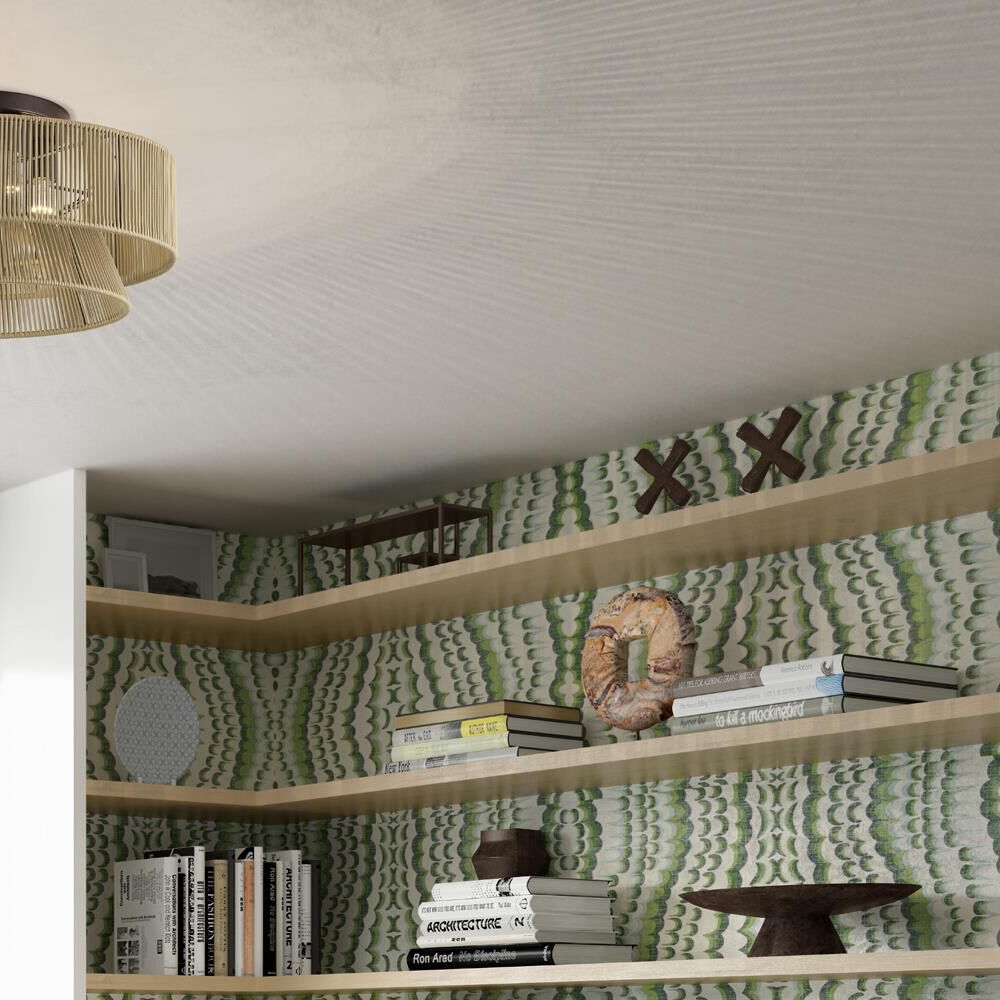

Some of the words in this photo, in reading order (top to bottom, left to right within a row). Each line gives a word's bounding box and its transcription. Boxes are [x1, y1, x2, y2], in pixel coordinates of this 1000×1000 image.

[715, 714, 725, 728] to
[726, 710, 739, 726] kill
[740, 712, 747, 724] a
[748, 701, 806, 722] mockingbird
[427, 916, 502, 933] ARCHITECTURE
[412, 953, 430, 964] Ron
[432, 951, 454, 963] Arad
